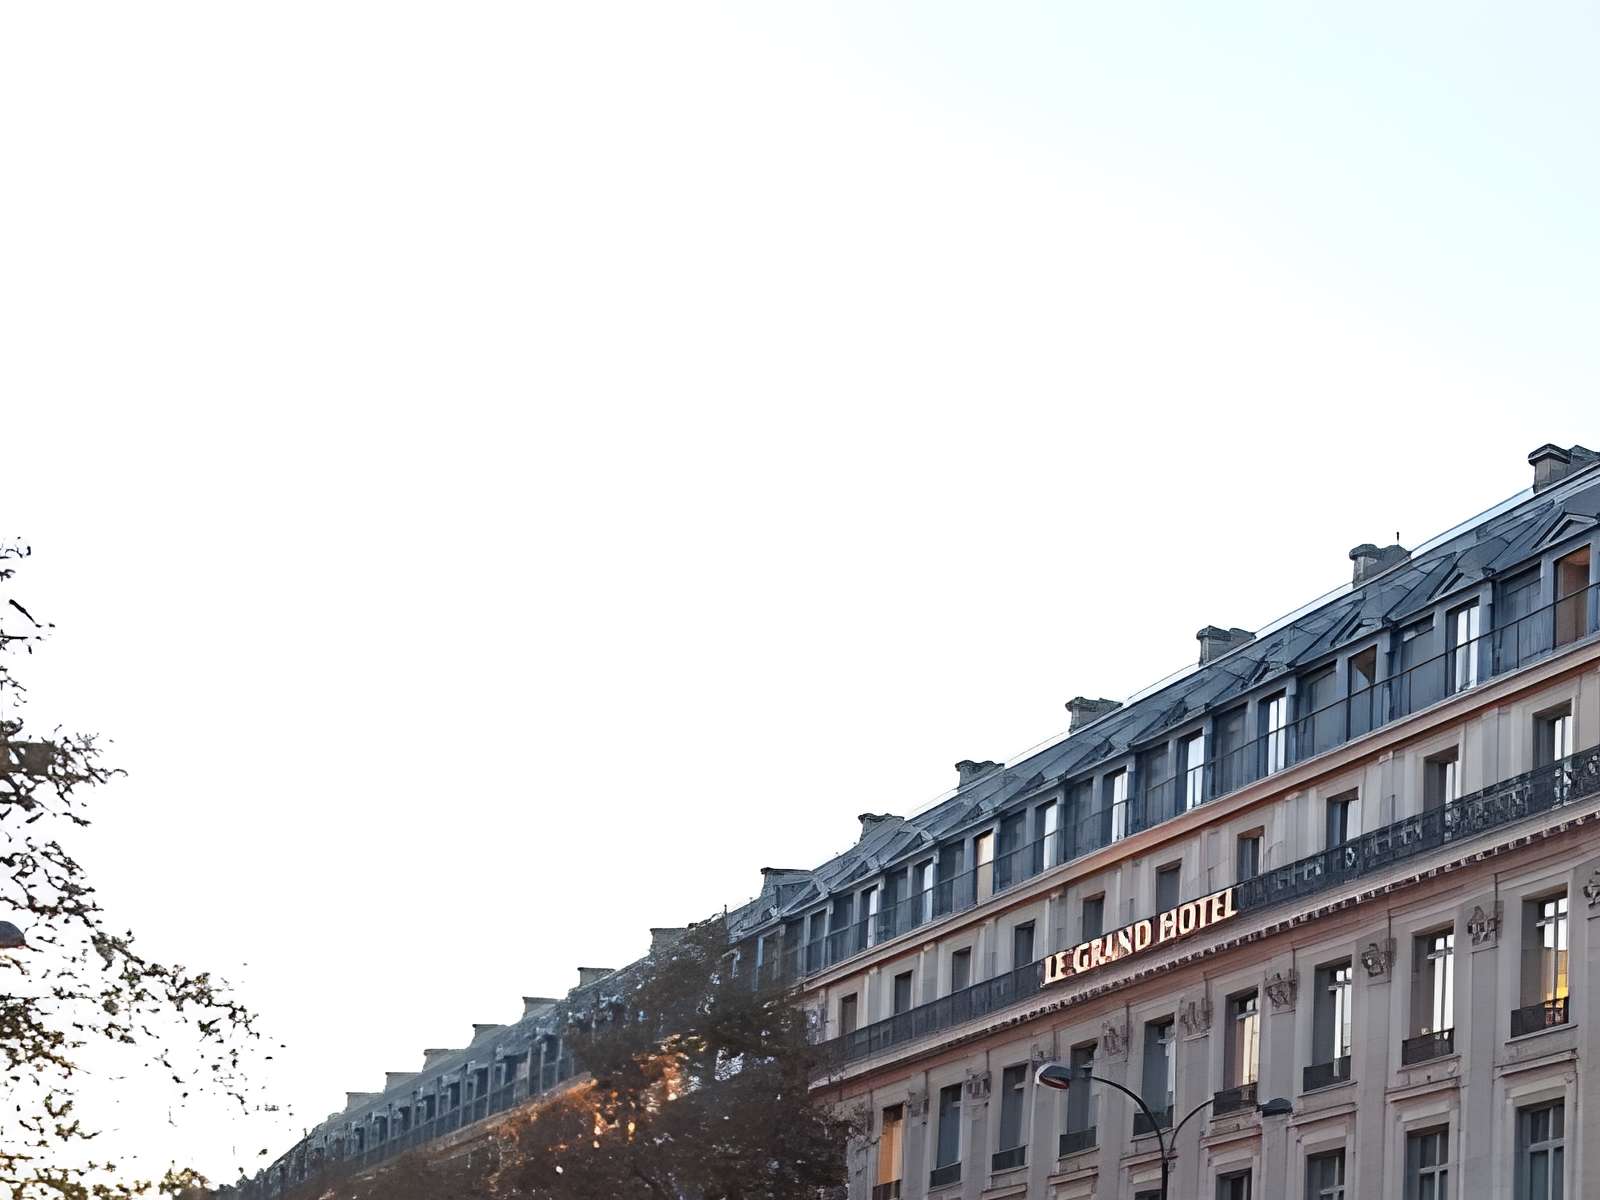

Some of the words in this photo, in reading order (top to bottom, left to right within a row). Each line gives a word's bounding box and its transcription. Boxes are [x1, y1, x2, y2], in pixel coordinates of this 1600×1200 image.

[1043, 950, 1075, 986] LE
[1073, 918, 1152, 975] GRAND
[1159, 887, 1239, 944] HOTEL
